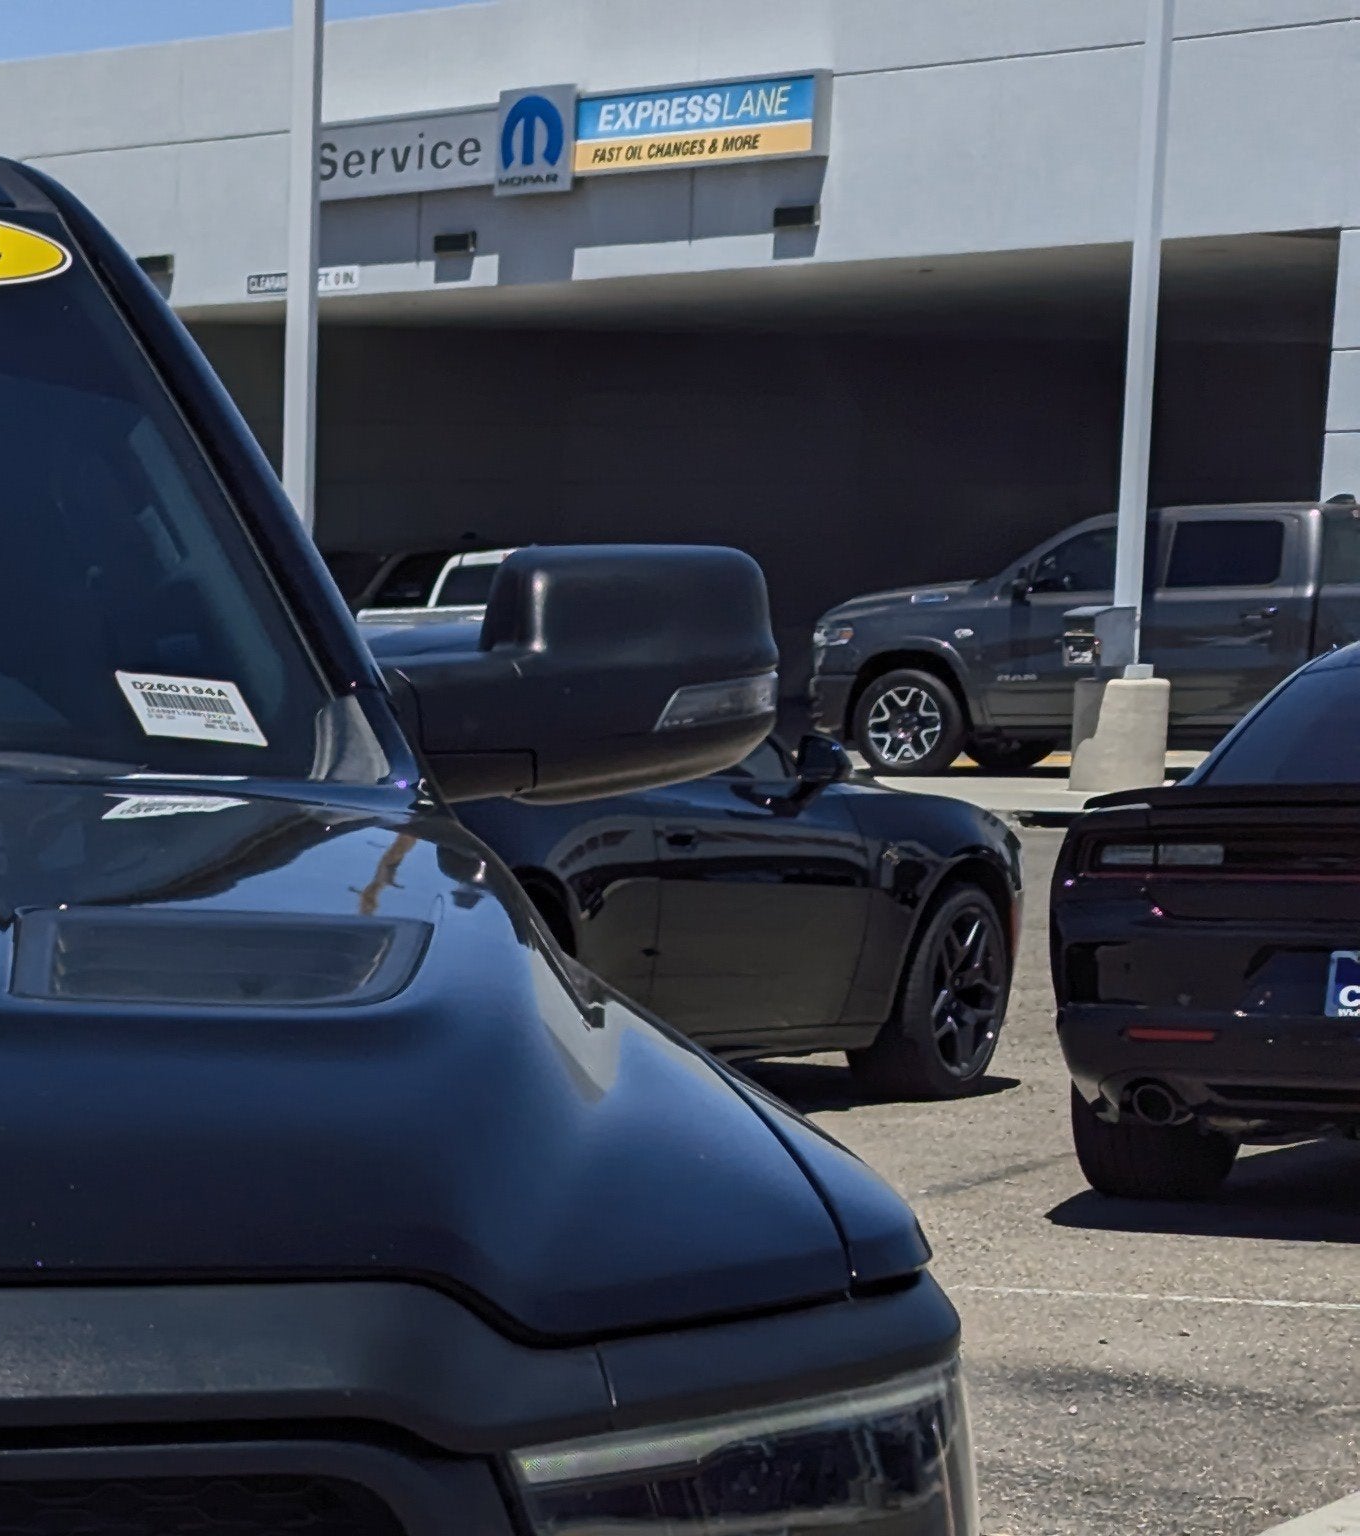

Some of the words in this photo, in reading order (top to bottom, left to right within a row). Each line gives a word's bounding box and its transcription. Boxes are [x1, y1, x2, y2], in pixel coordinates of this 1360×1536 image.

[320, 132, 482, 181] Service
[592, 146, 623, 163] FAST
[624, 145, 643, 161] OIL
[647, 138, 706, 159] CHANGES
[721, 133, 762, 151] MORE
[499, 174, 558, 186] MOPAR
